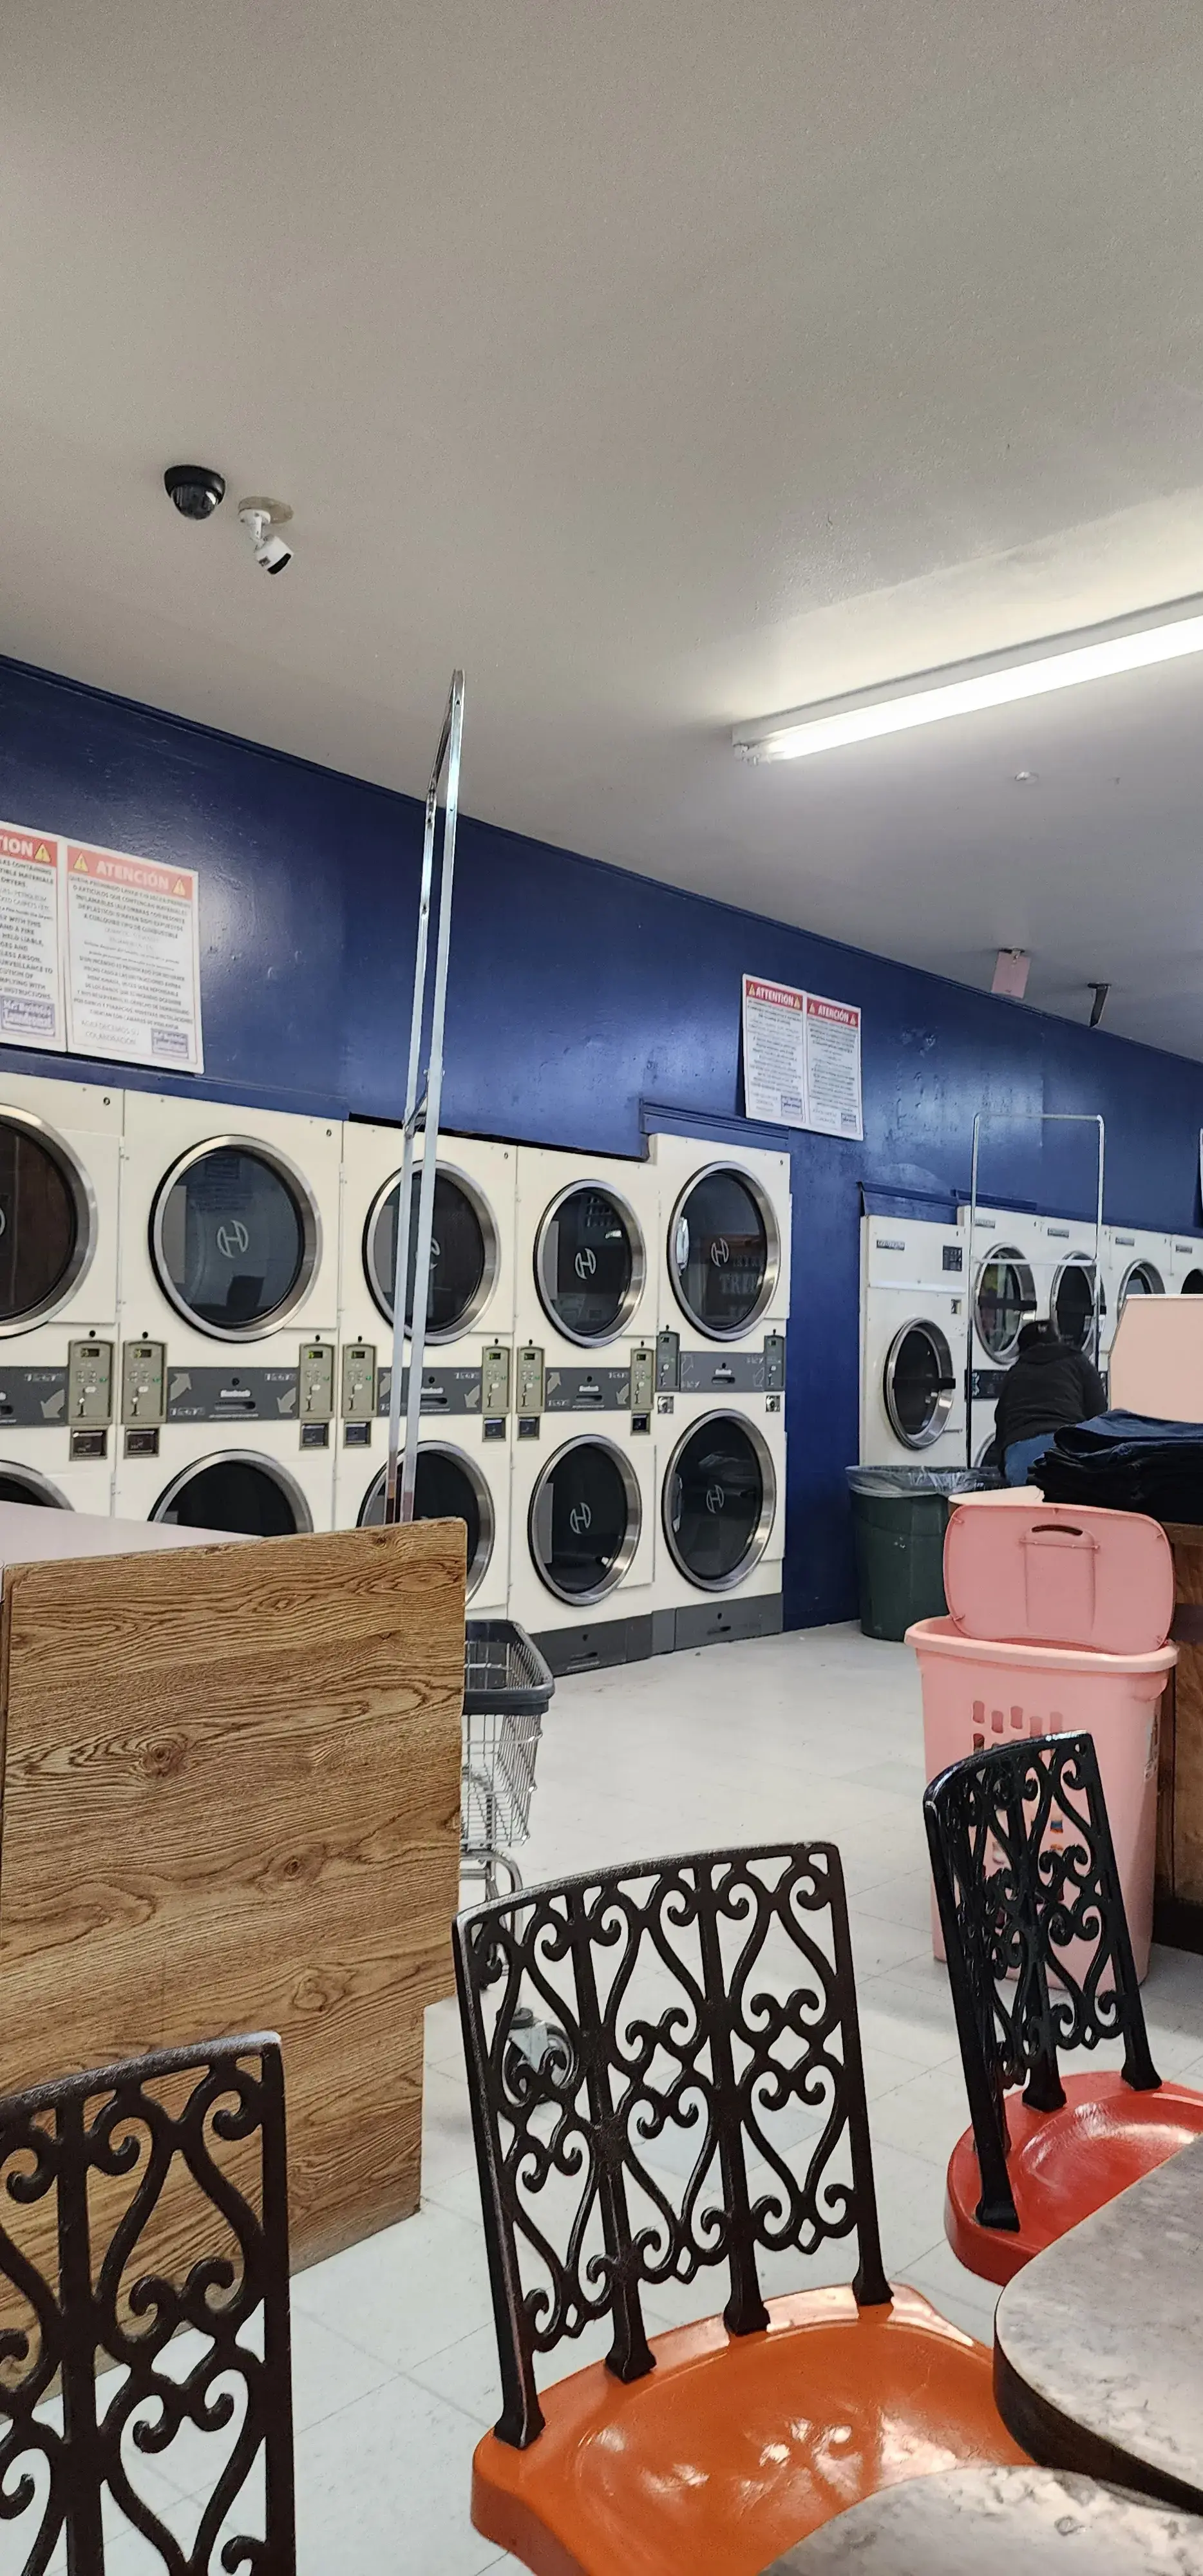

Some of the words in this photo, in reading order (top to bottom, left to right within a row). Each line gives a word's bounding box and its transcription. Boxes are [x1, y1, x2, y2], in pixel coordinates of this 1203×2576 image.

[0, 835, 33, 857] ION
[97, 861, 169, 890] ATENCIÓN
[756, 987, 793, 1007] ATTENTION
[818, 1004, 849, 1023] ATENCIÓN
